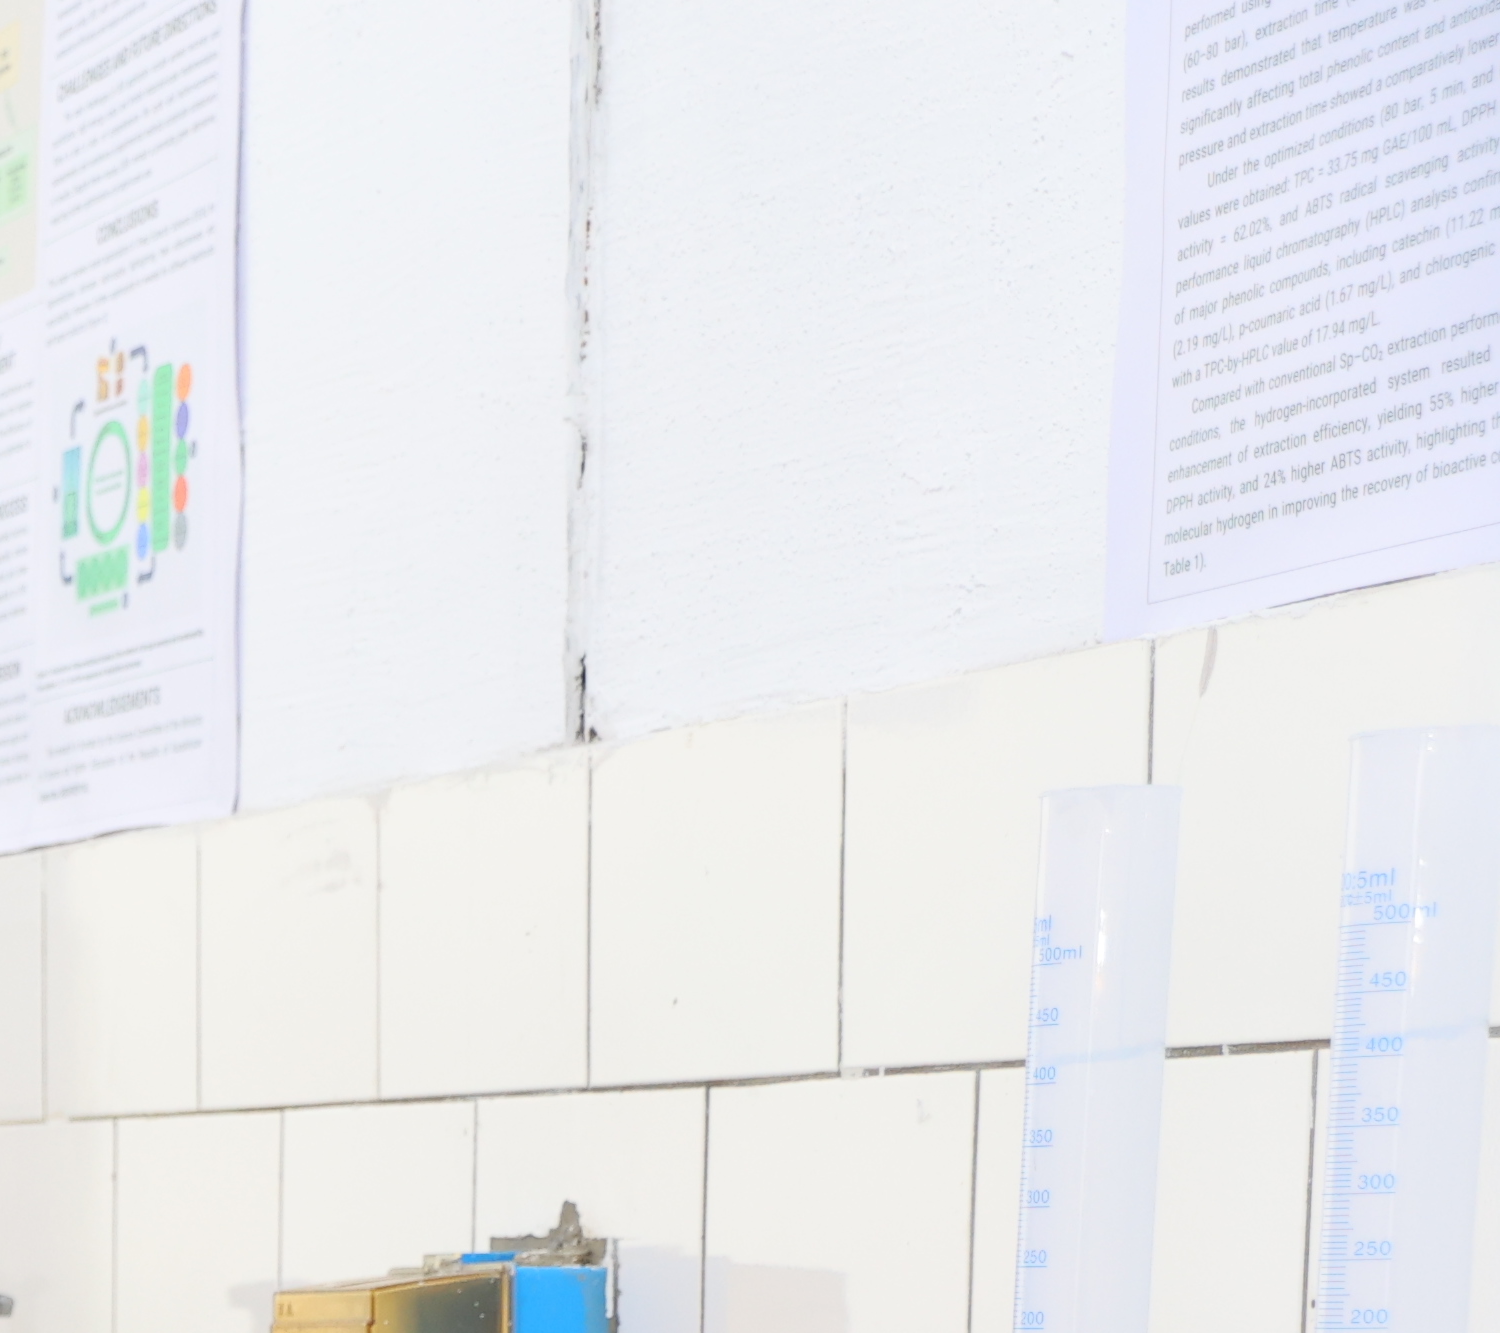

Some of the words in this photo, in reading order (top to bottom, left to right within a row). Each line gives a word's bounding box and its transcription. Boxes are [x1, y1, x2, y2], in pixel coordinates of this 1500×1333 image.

[1185, 9, 1235, 41] performed
[1255, 11, 1307, 40] extraction
[1182, 77, 1214, 102] results
[1221, 46, 1295, 86] demonstrated
[1301, 35, 1322, 56] that
[1328, 8, 1396, 45] temperature
[1180, 99, 1242, 134] significantly
[1247, 77, 1294, 110] affecting
[1299, 65, 1323, 89] total
[1327, 46, 1372, 82] phenolic
[1377, 28, 1418, 58] content
[1425, 17, 1445, 38] and
[1179, 135, 1223, 170] pressure
[1227, 128, 1246, 149] and
[1250, 108, 1303, 141] extraction
[1306, 98, 1327, 120] time
[1330, 86, 1372, 109] showed
[1376, 80, 1382, 91] a
[1385, 48, 1464, 88] comparatively
[1468, 32, 1499, 55] lower
[1207, 166, 1238, 188] Under
[1243, 159, 1259, 174] the
[1264, 137, 1314, 170] optimized
[1319, 113, 1374, 147] conditions
[1380, 102, 1398, 128] (80
[1430, 88, 1437, 104] 5
[1472, 65, 1493, 89] and
[1178, 209, 1210, 229] values
[1215, 200, 1239, 216] were
[1243, 179, 1289, 207] obtained:
[1295, 167, 1314, 188] TPC
[1327, 151, 1357, 176] 33.75
[1361, 148, 1378, 166] mg
[1383, 124, 1432, 156] GAE/100
[1462, 100, 1497, 126] DPPH
[1178, 238, 1213, 261] activity
[1280, 208, 1298, 226] and
[1305, 193, 1333, 217] ABTS
[1340, 176, 1377, 204] radical
[1385, 153, 1448, 189] scavenging
[1457, 136, 1499, 163] activity
[1175, 263, 1239, 297] performance
[1244, 248, 1271, 271] liquid
[1276, 218, 1359, 259] chromatography
[1366, 195, 1404, 231] (HPLC)
[1411, 184, 1457, 213] analysis
[1174, 306, 1185, 326] of
[1189, 296, 1217, 323] major
[1222, 283, 1264, 313] phenolic
[1269, 261, 1331, 293] compounds,
[1336, 243, 1386, 271] including
[1392, 226, 1439, 253] catechin
[1446, 208, 1483, 239] (11.22
[1173, 332, 1198, 361] (2.19
[1239, 304, 1295, 336] p-coumaric
[1299, 296, 1320, 317] acid
[1326, 284, 1352, 312] (1.67
[1400, 262, 1420, 285] and
[1426, 244, 1495, 277] chlorogenic
[1171, 371, 1192, 389] with
[1195, 370, 1200, 381] a
[1204, 344, 1269, 380] TPC-by-HPLC
[1272, 338, 1298, 357] value
[1301, 330, 1313, 348] of
[1316, 320, 1345, 344] 17.94
[1191, 390, 1241, 415] Compared
[1245, 379, 1264, 397] with
[1268, 356, 1336, 391] conventional
[1387, 322, 1446, 356] extraction
[1450, 310, 1500, 340] perform
[1169, 425, 1221, 451] conditions,
[1230, 417, 1245, 434] the
[1255, 380, 1377, 427] hydrogen-incorporated
[1388, 365, 1430, 390] system
[1442, 345, 1490, 374] resulted
[1167, 453, 1232, 482] enhancement
[1238, 445, 1248, 464] of
[1254, 432, 1307, 459] extraction
[1313, 417, 1371, 444] efficiency,
[1377, 402, 1422, 429] yielding
[1430, 392, 1454, 413] 55%
[1461, 381, 1498, 406] higher
[1166, 494, 1193, 514] DPPH
[1240, 474, 1258, 495] and
[1264, 470, 1285, 489] 24%
[1291, 457, 1325, 483] higher
[1331, 450, 1361, 472] ABTS
[1367, 440, 1410, 462] activity,
[1416, 419, 1485, 452] highlighting
[1164, 522, 1212, 546] molecular
[1216, 507, 1264, 534] hydrogen
[1268, 504, 1278, 519] in
[1282, 490, 1336, 516] improving
[1341, 484, 1359, 501] the
[1363, 470, 1411, 496] recovery
[1416, 464, 1428, 482] of
[1433, 451, 1486, 480] bioactive
[1163, 552, 1190, 577] Table
[1373, 902, 1437, 921] 500ml
[1038, 945, 1083, 962] 500ml
[1369, 971, 1407, 986] 450
[1036, 1008, 1059, 1022] 450
[1366, 1037, 1403, 1052] 400
[1033, 1067, 1056, 1080] 400
[1361, 1107, 1399, 1122] 350
[1029, 1130, 1052, 1144] 350
[1358, 1174, 1395, 1189] 300
[1026, 1190, 1050, 1204] 300
[1023, 1250, 1047, 1264] 250
[1353, 1241, 1392, 1256] 250
[1021, 1312, 1044, 1325] 200
[1351, 1309, 1388, 1324] 200
